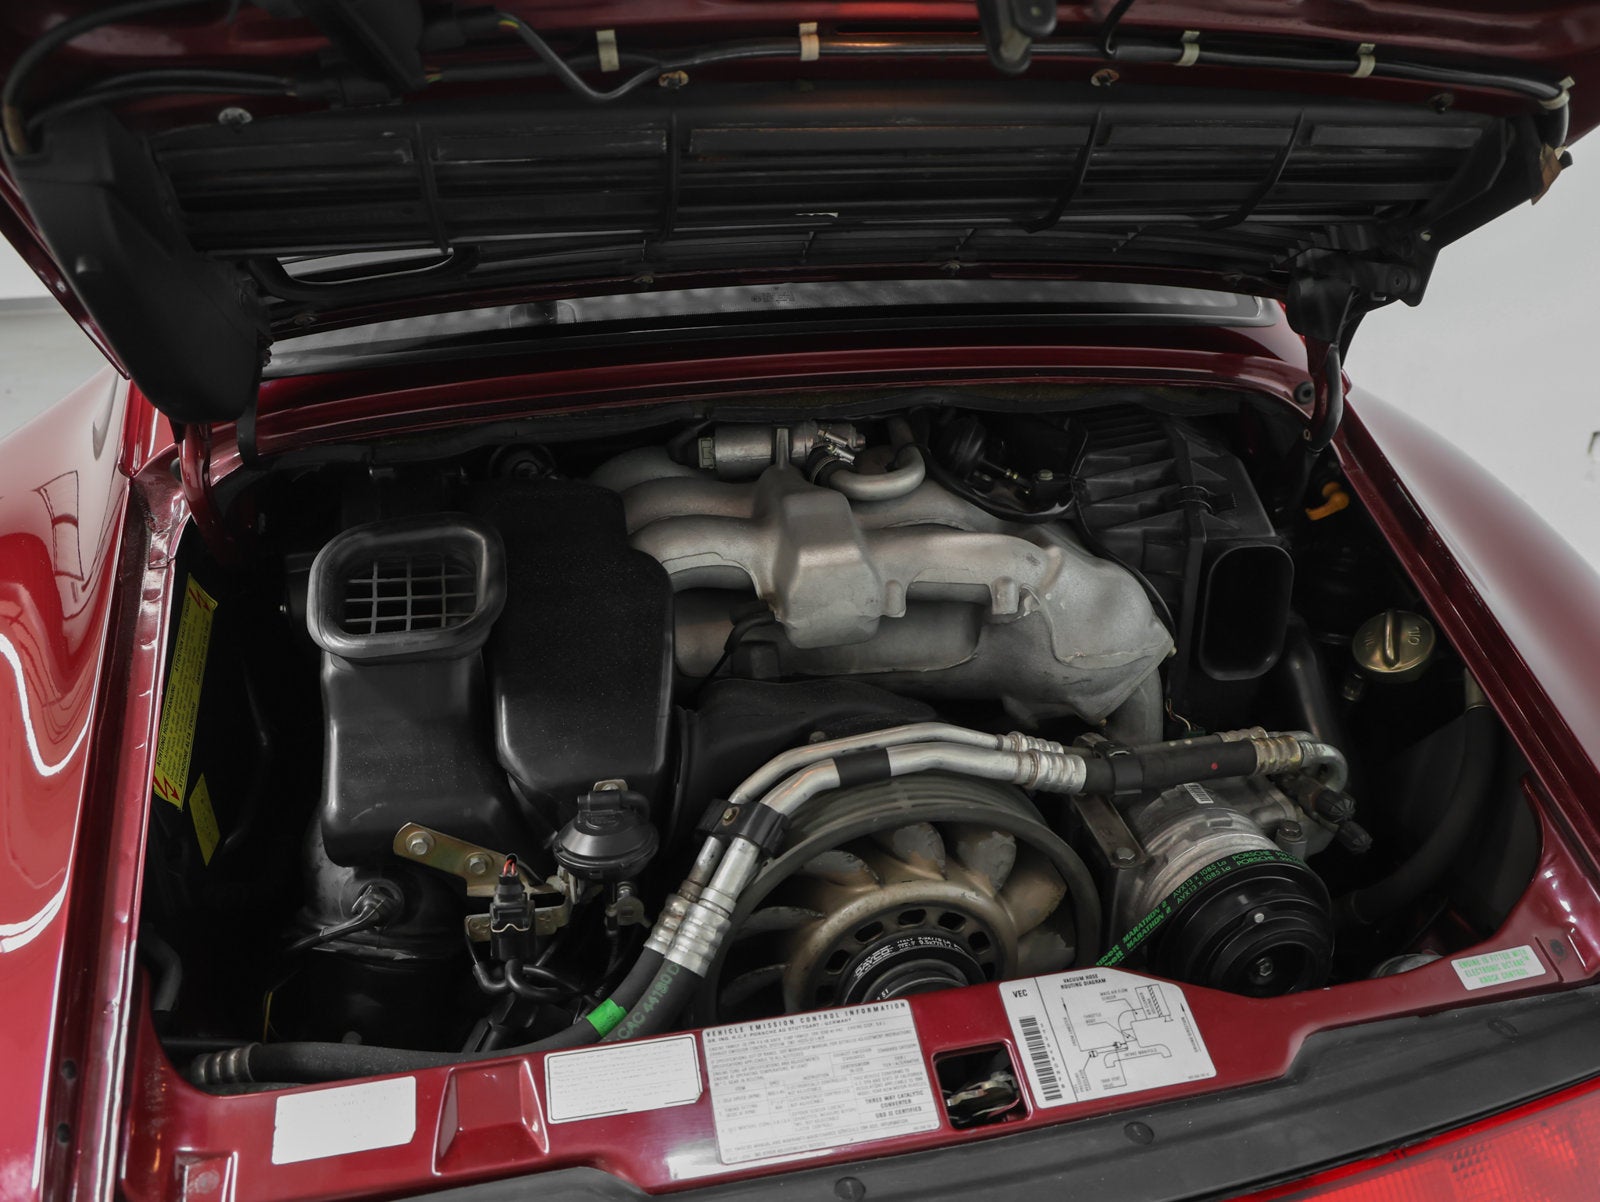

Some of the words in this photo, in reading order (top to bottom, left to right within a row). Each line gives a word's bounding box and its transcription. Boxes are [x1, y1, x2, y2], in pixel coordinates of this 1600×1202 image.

[1236, 854, 1275, 867] PORSCHE
[1122, 906, 1161, 944] MARATHON
[1126, 912, 1165, 950] MARATHON
[1060, 982, 1083, 990] ROUTING
[1083, 978, 1106, 986] DIAGRAM
[1063, 976, 1084, 984] VACUUM
[1012, 989, 1029, 999] VEC
[617, 1011, 646, 1039] CAC
[705, 1026, 744, 1038] VEHICLE
[749, 1019, 795, 1032] EMISSION
[800, 1012, 840, 1024] CONTROL
[844, 1002, 906, 1017] INFORMATION
[749, 1029, 777, 1037] PORSCHE
[824, 1017, 852, 1026] GERMANY
[880, 1098, 912, 1108] CONVERTER
[894, 1106, 922, 1115] CERTIFIED
